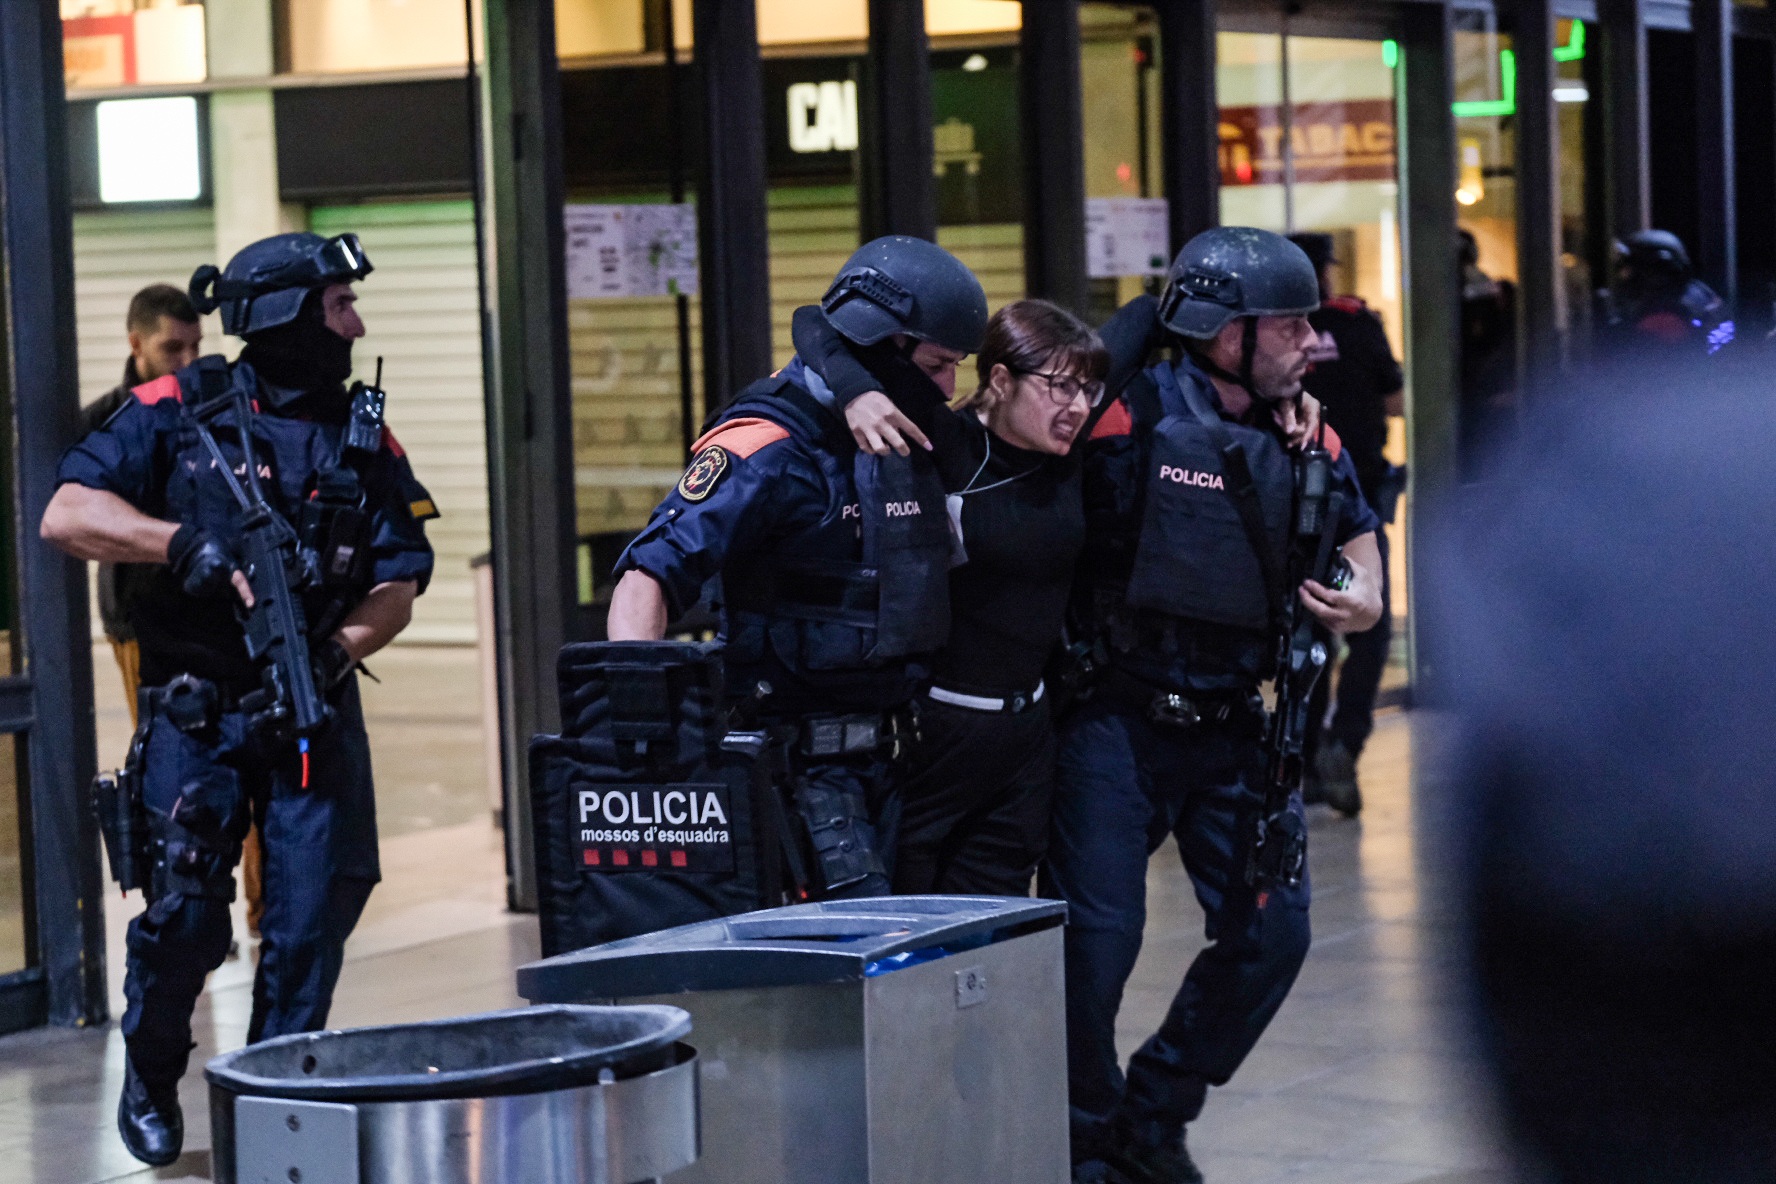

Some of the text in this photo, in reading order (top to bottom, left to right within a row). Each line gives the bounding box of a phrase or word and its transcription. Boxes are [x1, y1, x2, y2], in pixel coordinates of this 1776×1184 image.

[1160, 465, 1224, 490] POLICIA
[886, 501, 921, 517] POLICIA
[578, 790, 728, 824] POLICIA
[581, 826, 729, 846] mossos d'esquadra
